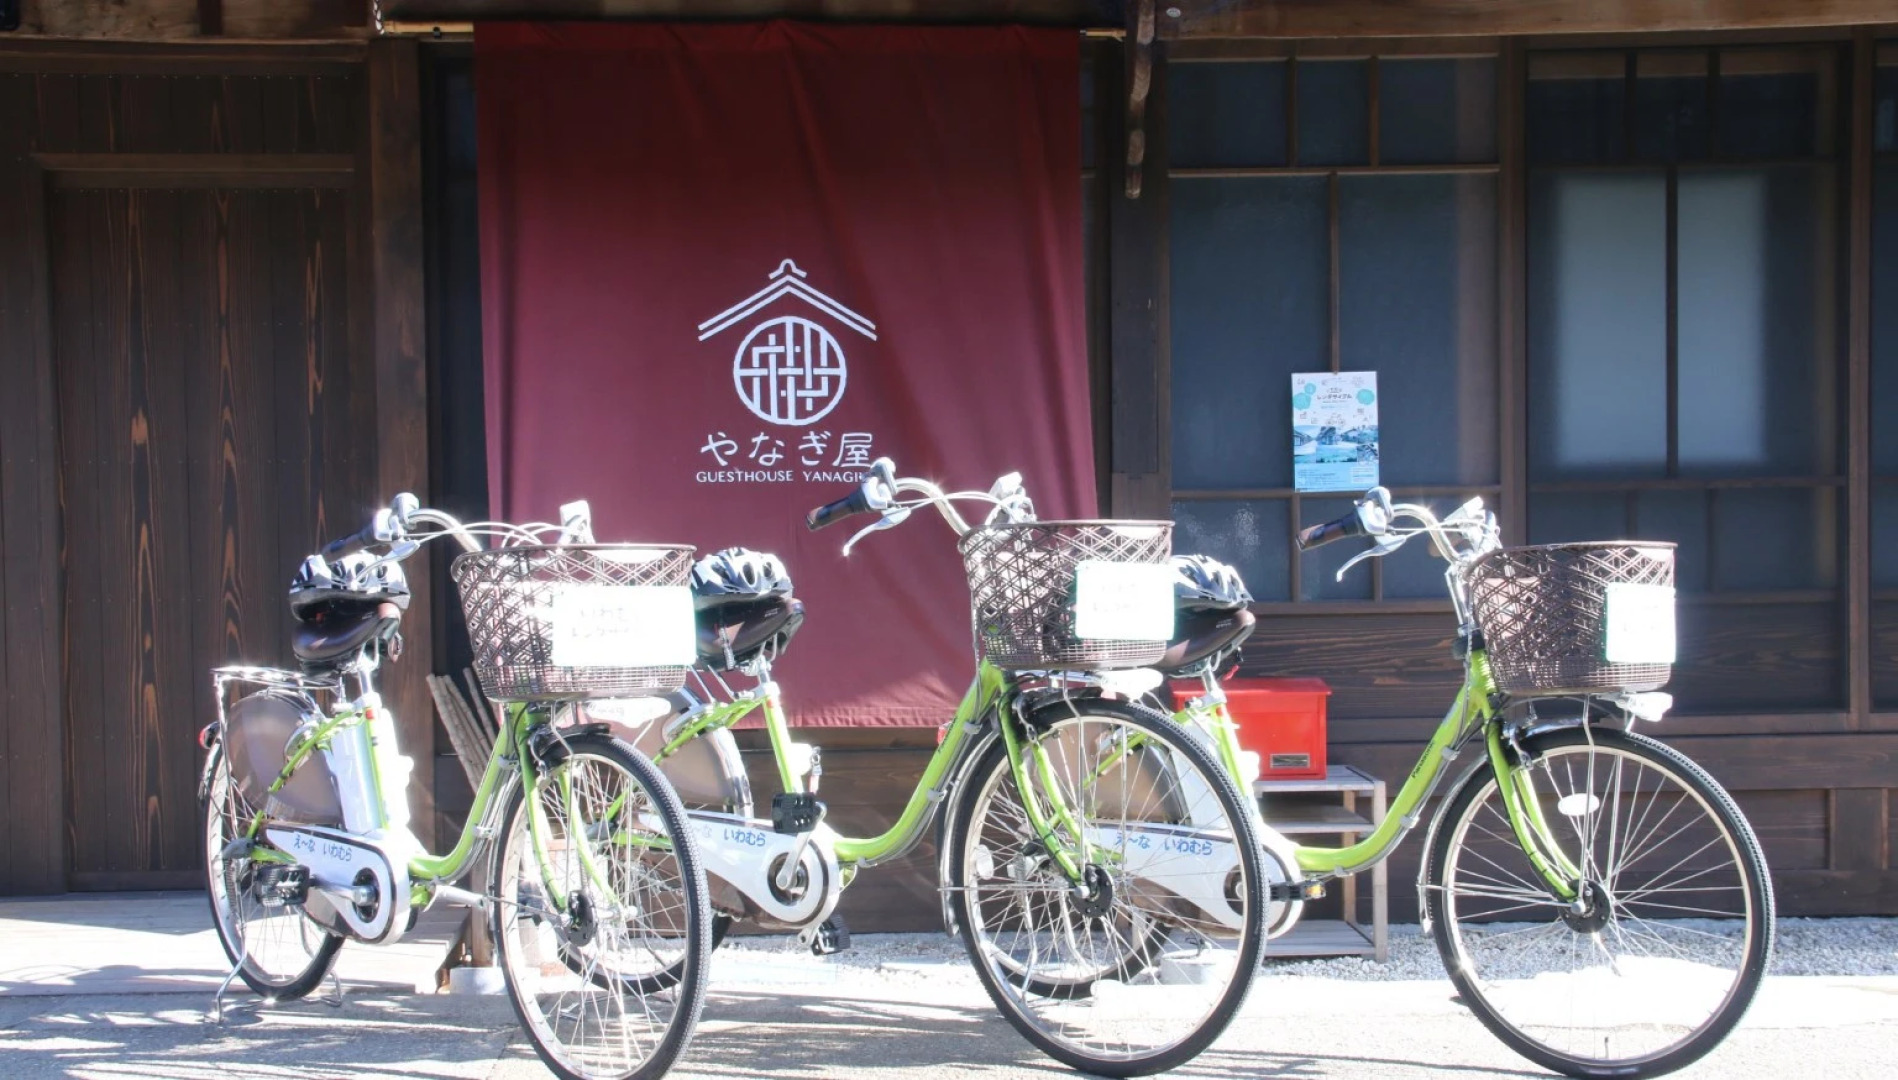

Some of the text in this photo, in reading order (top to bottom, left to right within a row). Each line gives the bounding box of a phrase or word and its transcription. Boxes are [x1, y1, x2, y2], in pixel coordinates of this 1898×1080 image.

[700, 430, 873, 467] やなぎ屋
[696, 470, 863, 483] GUESTHOUSE YANAGI
[723, 827, 767, 847] いわむら
[1163, 836, 1214, 856] いわむら
[323, 843, 353, 862] いわむら
